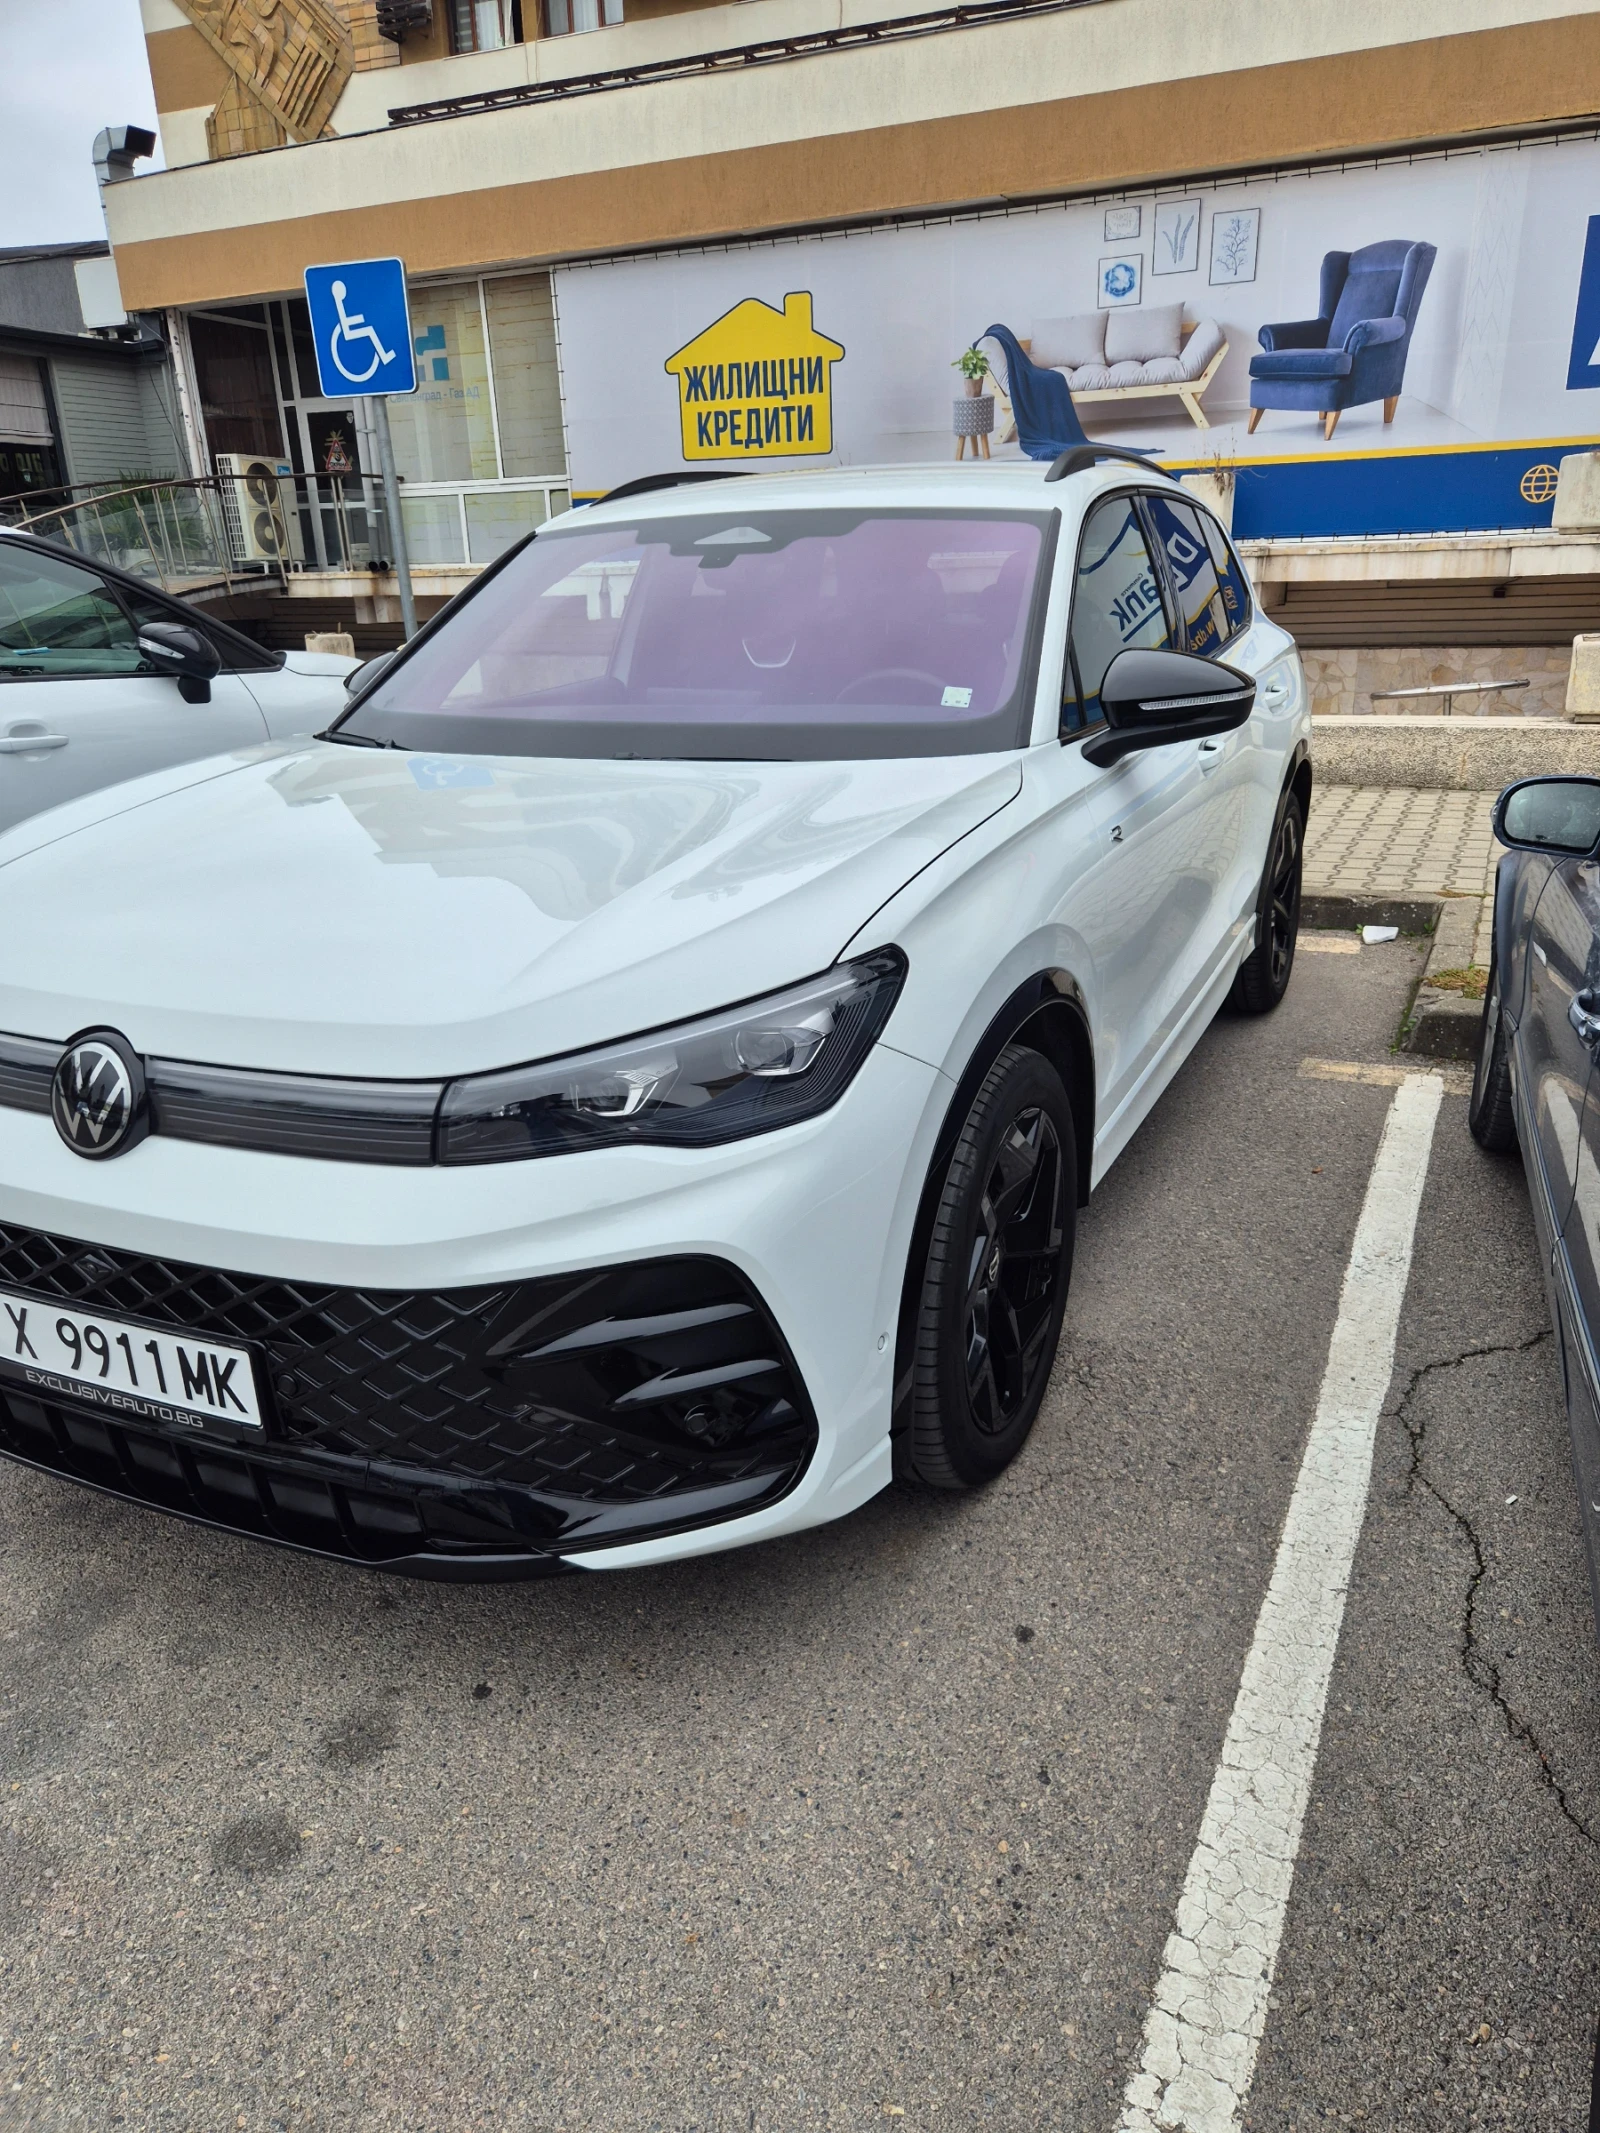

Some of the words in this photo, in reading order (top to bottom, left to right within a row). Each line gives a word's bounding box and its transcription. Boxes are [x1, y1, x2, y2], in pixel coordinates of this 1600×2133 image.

[683, 356, 824, 402] ЖИЛИЩНИ
[697, 404, 813, 449] КРЕДИТИ
[55, 1317, 168, 1395] 9911
[176, 1345, 249, 1414] MK
